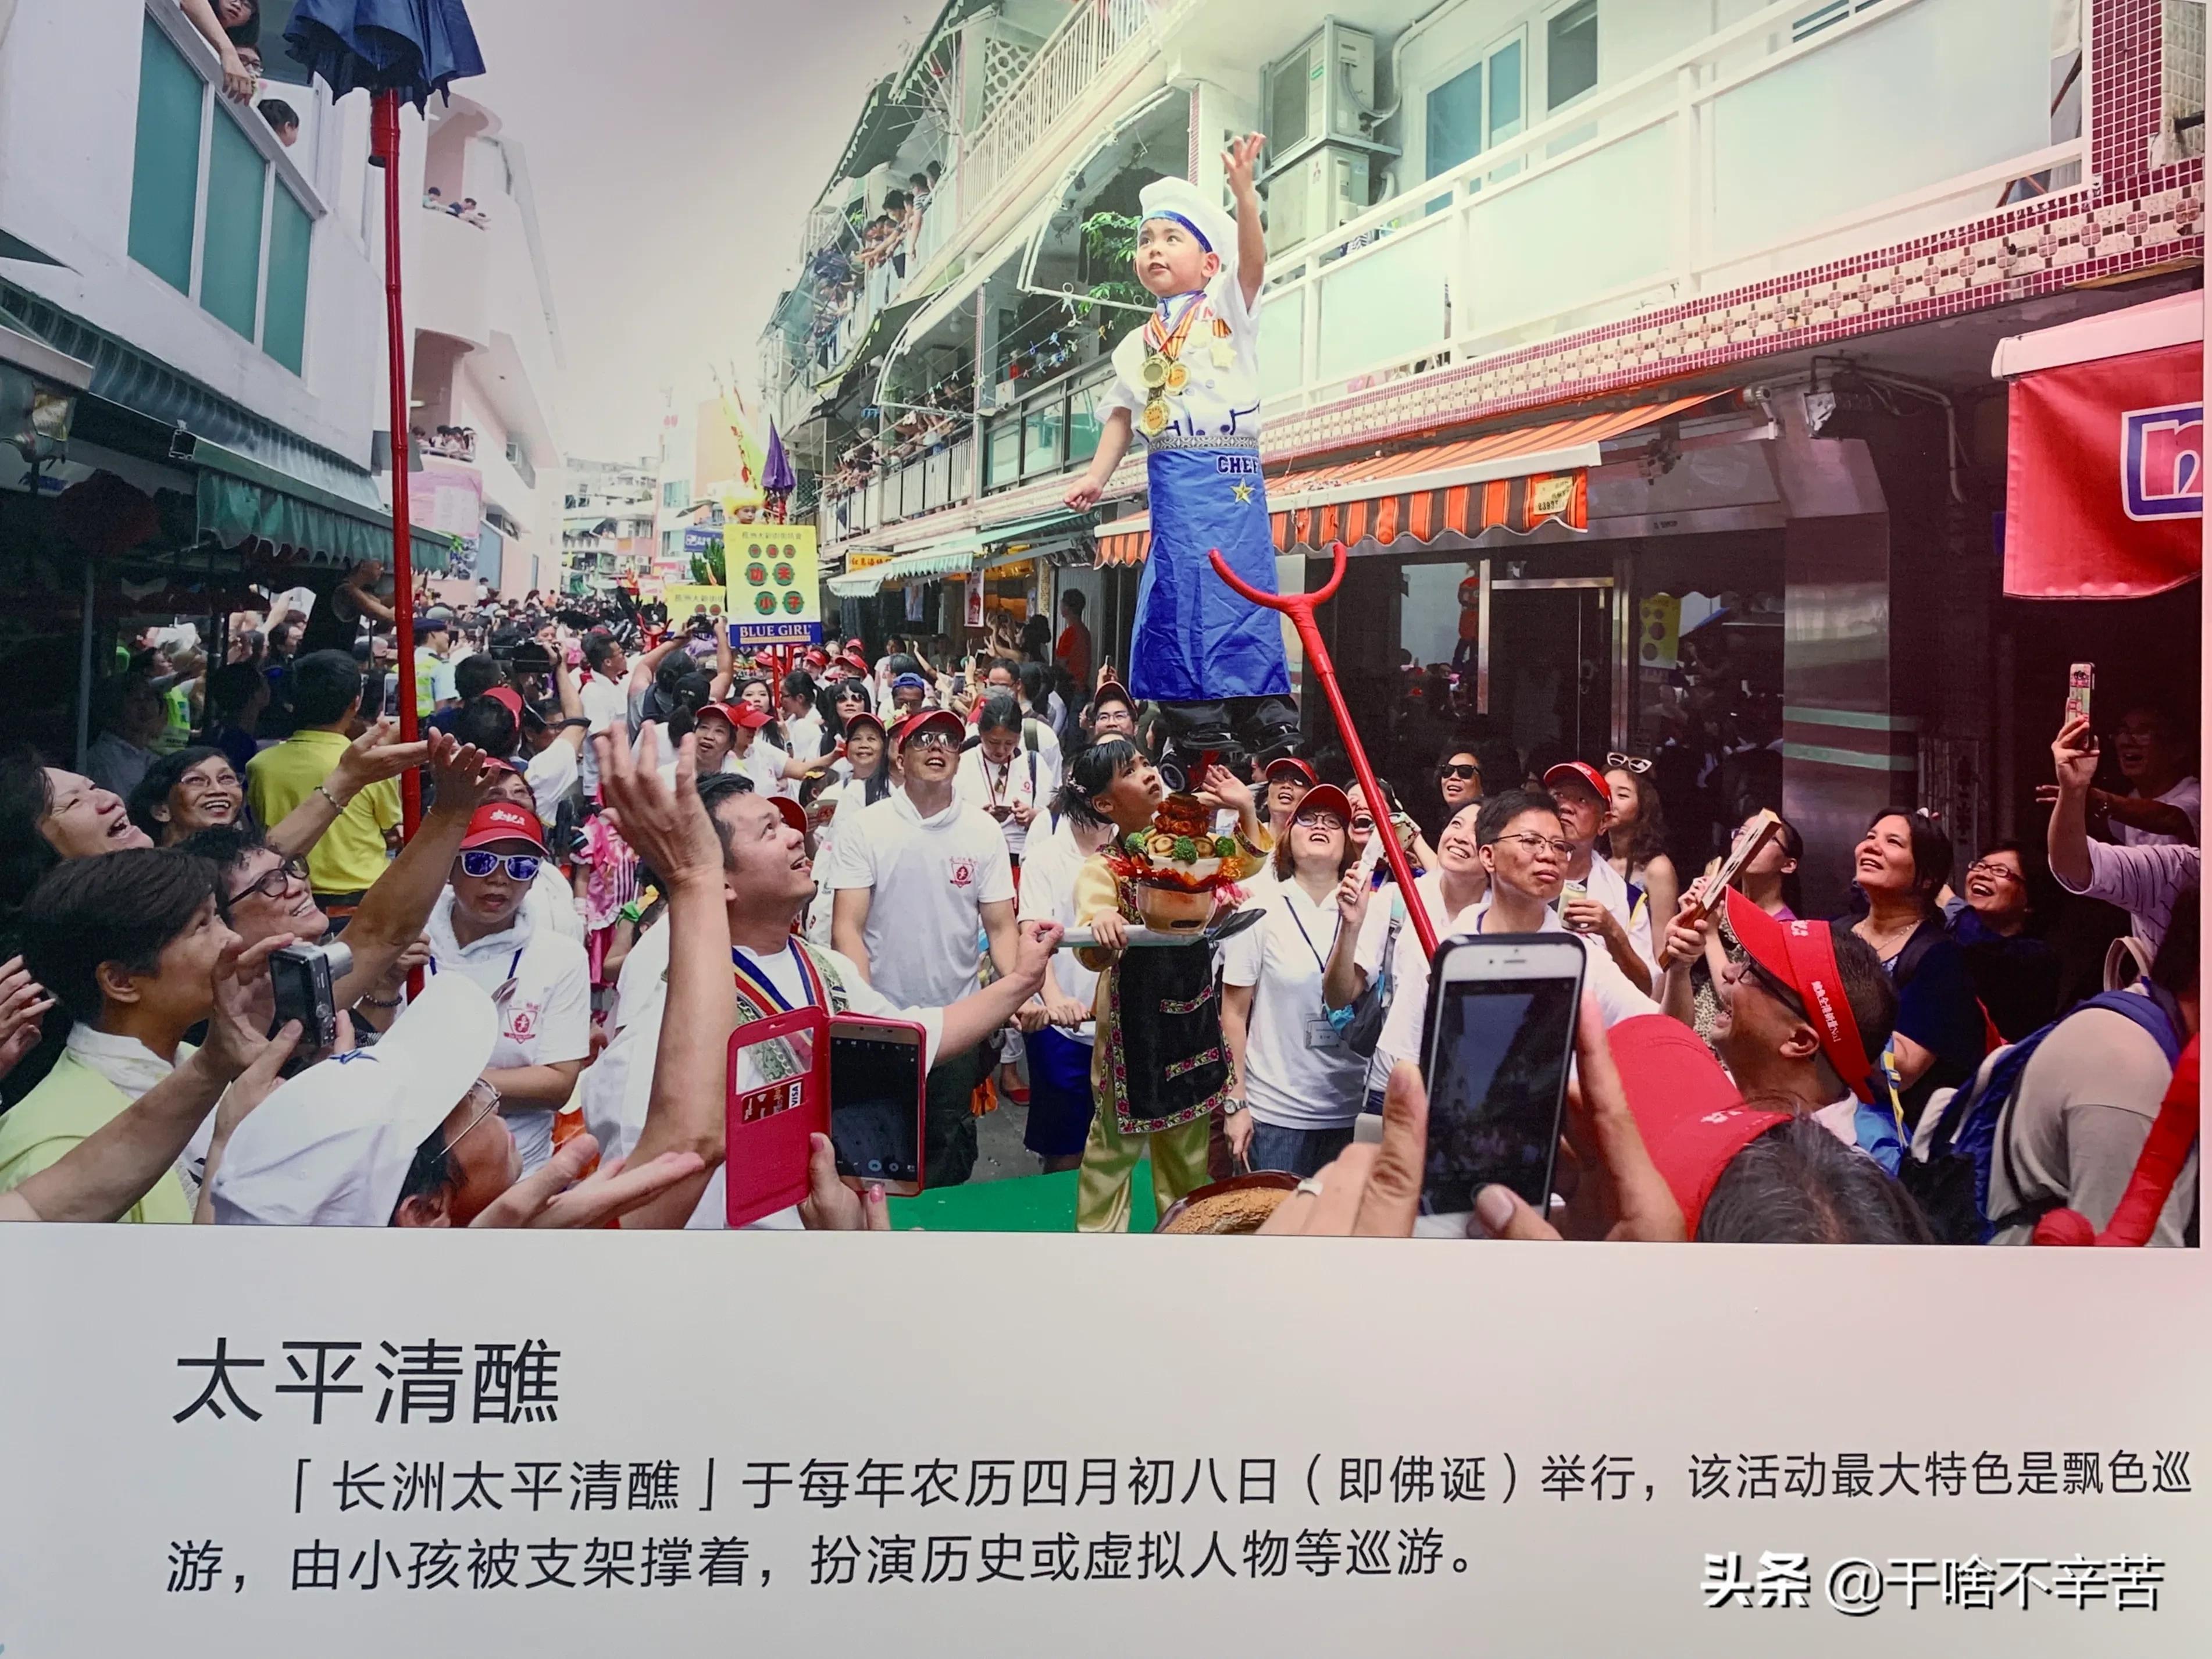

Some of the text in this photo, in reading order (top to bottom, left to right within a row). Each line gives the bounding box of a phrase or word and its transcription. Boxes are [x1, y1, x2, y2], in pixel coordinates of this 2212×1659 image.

[1217, 455, 1258, 474] CHEF
[740, 624, 811, 637] BLUE GIRL
[173, 1337, 562, 1425] 太平清醮
